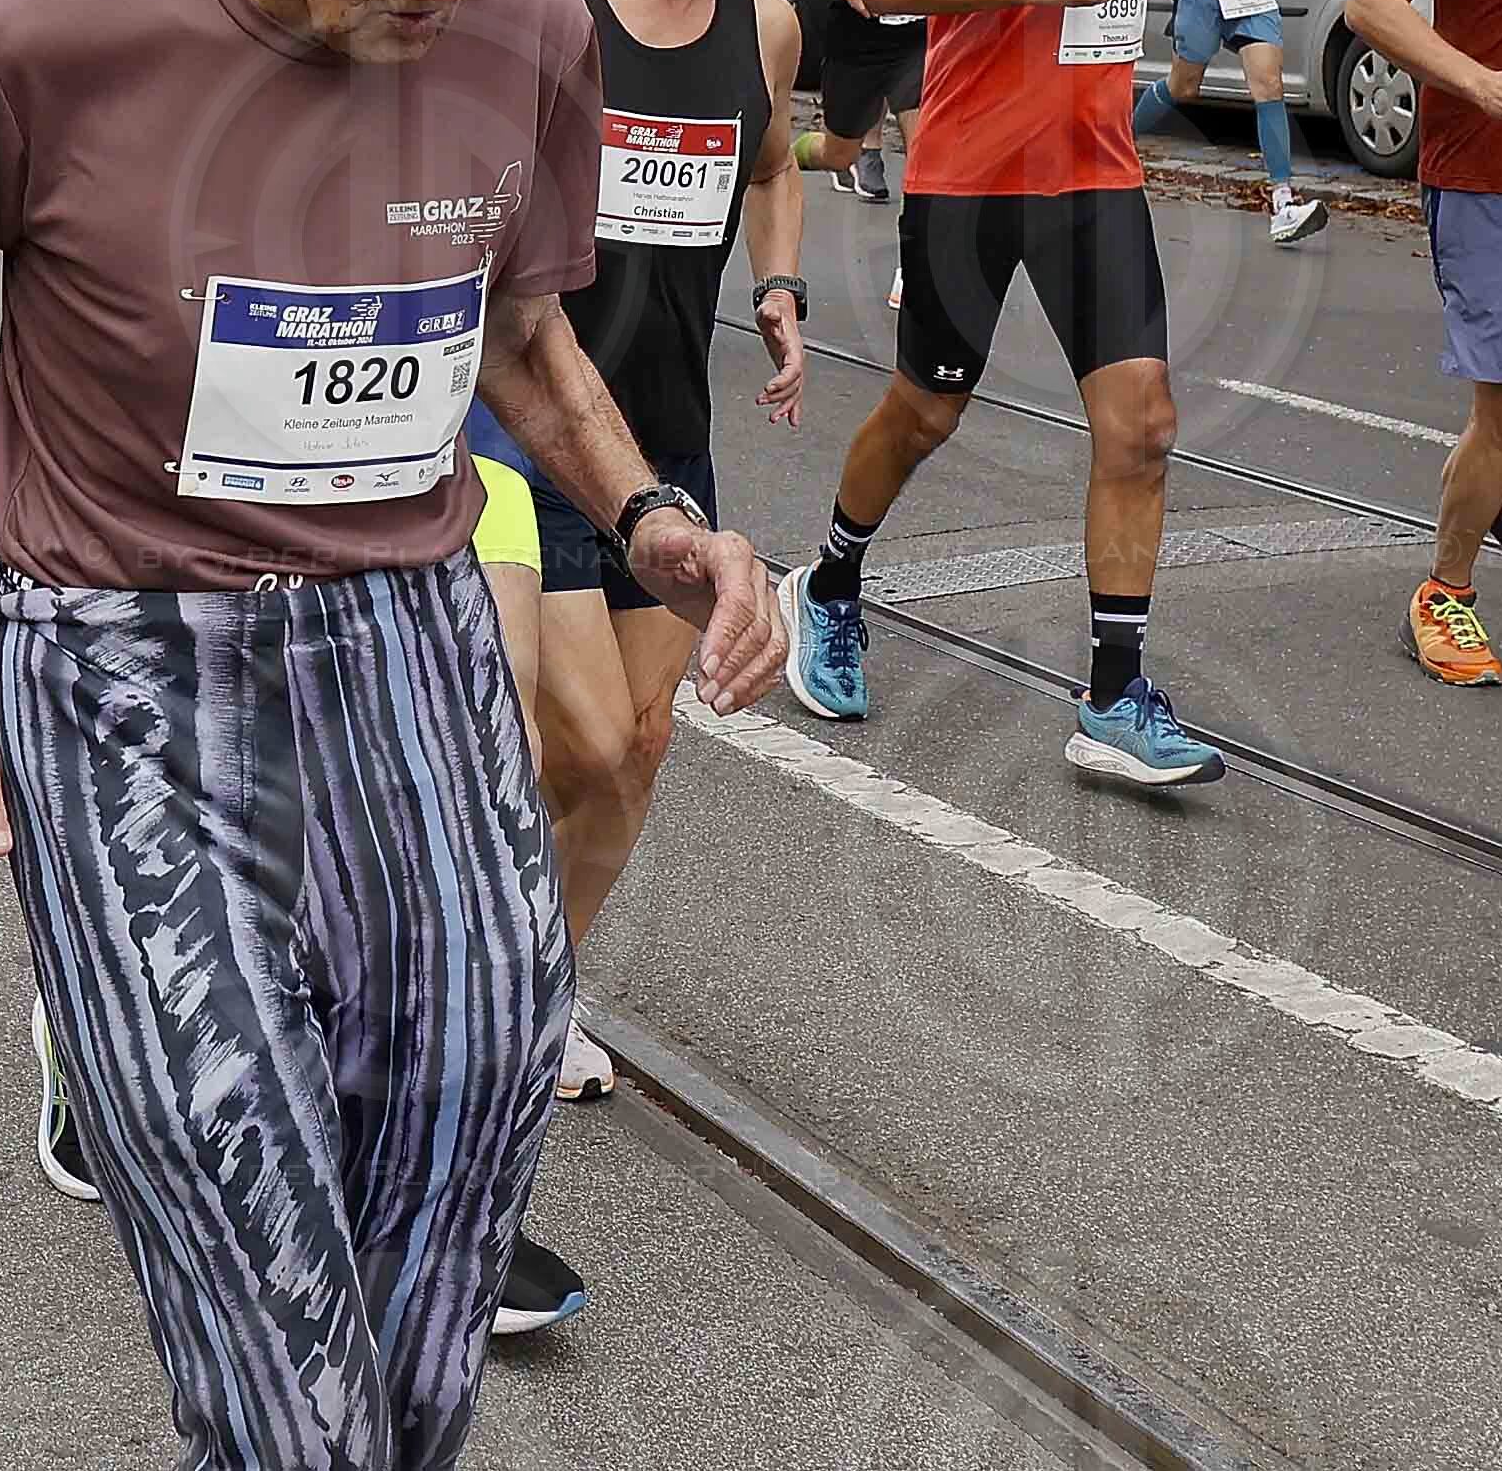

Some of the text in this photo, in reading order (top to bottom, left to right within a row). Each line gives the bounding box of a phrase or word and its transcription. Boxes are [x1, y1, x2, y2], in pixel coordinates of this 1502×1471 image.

[626, 135, 680, 148] MARATHON
[620, 157, 708, 189] 20061
[423, 197, 484, 221] GRAZ
[634, 205, 684, 219] Christian
[410, 222, 466, 236] MARATHON
[451, 234, 475, 245] 2023
[283, 306, 333, 323] GRAZ
[276, 320, 377, 338] MARATHON
[295, 355, 420, 406] 1820
[284, 413, 413, 430] Kleine Zeitung Marathon
